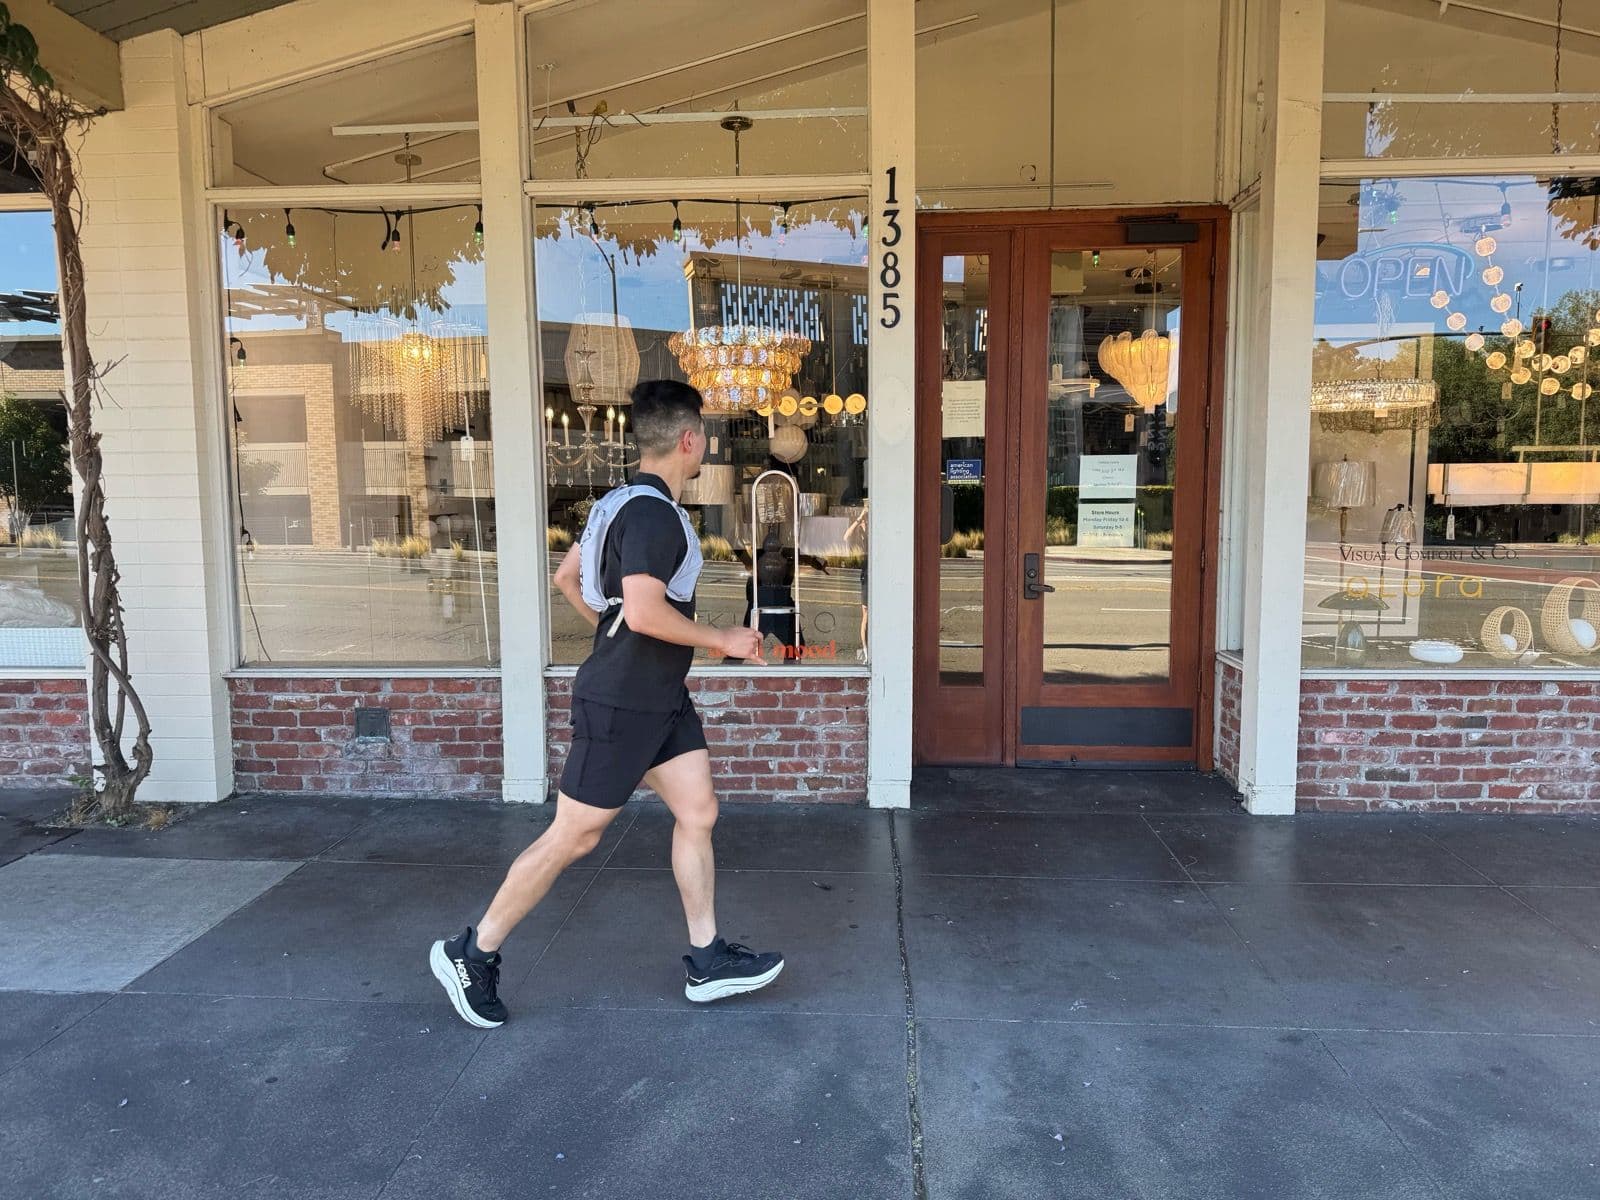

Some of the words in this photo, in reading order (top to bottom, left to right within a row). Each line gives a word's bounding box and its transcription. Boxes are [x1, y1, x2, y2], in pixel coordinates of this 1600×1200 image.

[880, 166, 902, 328] 1385
[1341, 255, 1466, 298] OPEN
[1339, 545, 1390, 561] VISUAL
[1394, 545, 1463, 561] COMFORT
[1471, 546, 1488, 561] &
[772, 639, 836, 659] mood
[454, 958, 472, 989] HOKA
